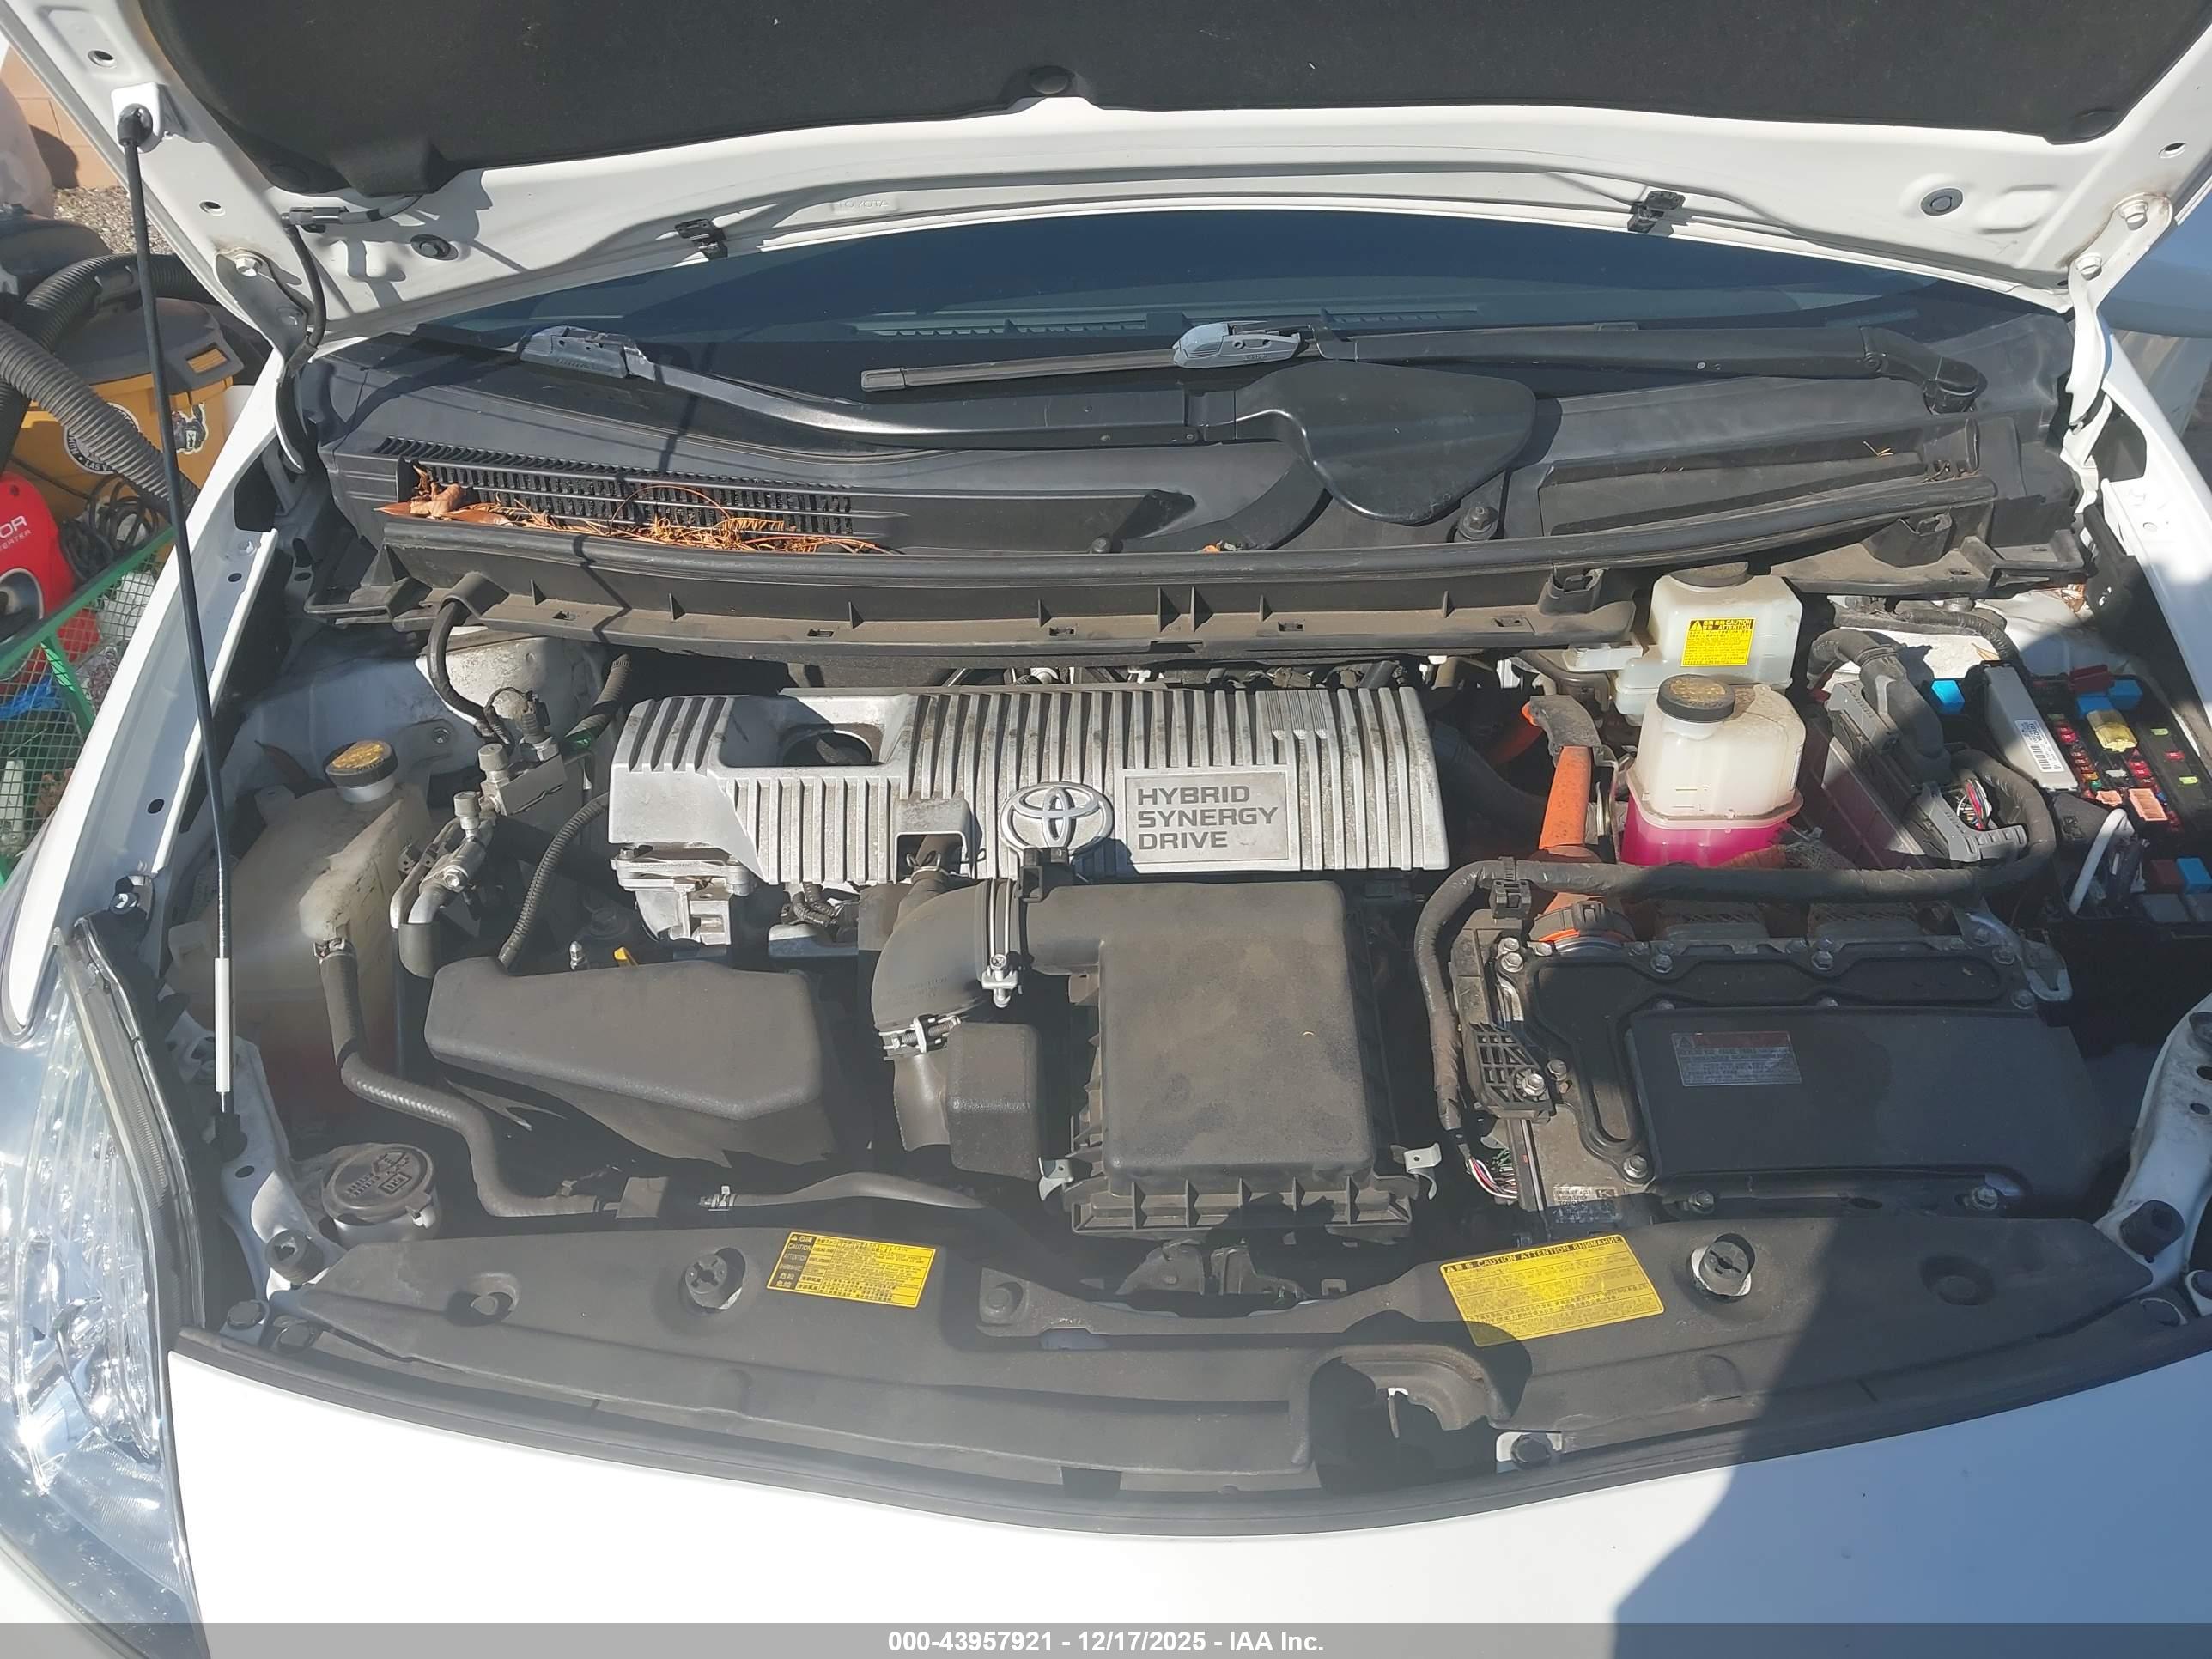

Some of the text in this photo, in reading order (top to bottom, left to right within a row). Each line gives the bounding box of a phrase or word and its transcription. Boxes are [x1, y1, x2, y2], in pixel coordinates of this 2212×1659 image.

[838, 199, 890, 210] TOYOTA
[1137, 785, 1250, 805] HYBRID
[1138, 806, 1279, 829] SYNERGY
[1138, 830, 1228, 850] DRIVE
[787, 1243, 812, 1251] CAUTION
[1477, 1255, 1517, 1267] CAUTION
[1521, 1245, 1571, 1260] ATTENTION
[1572, 1237, 1622, 1251] ВНИМАНИЕ
